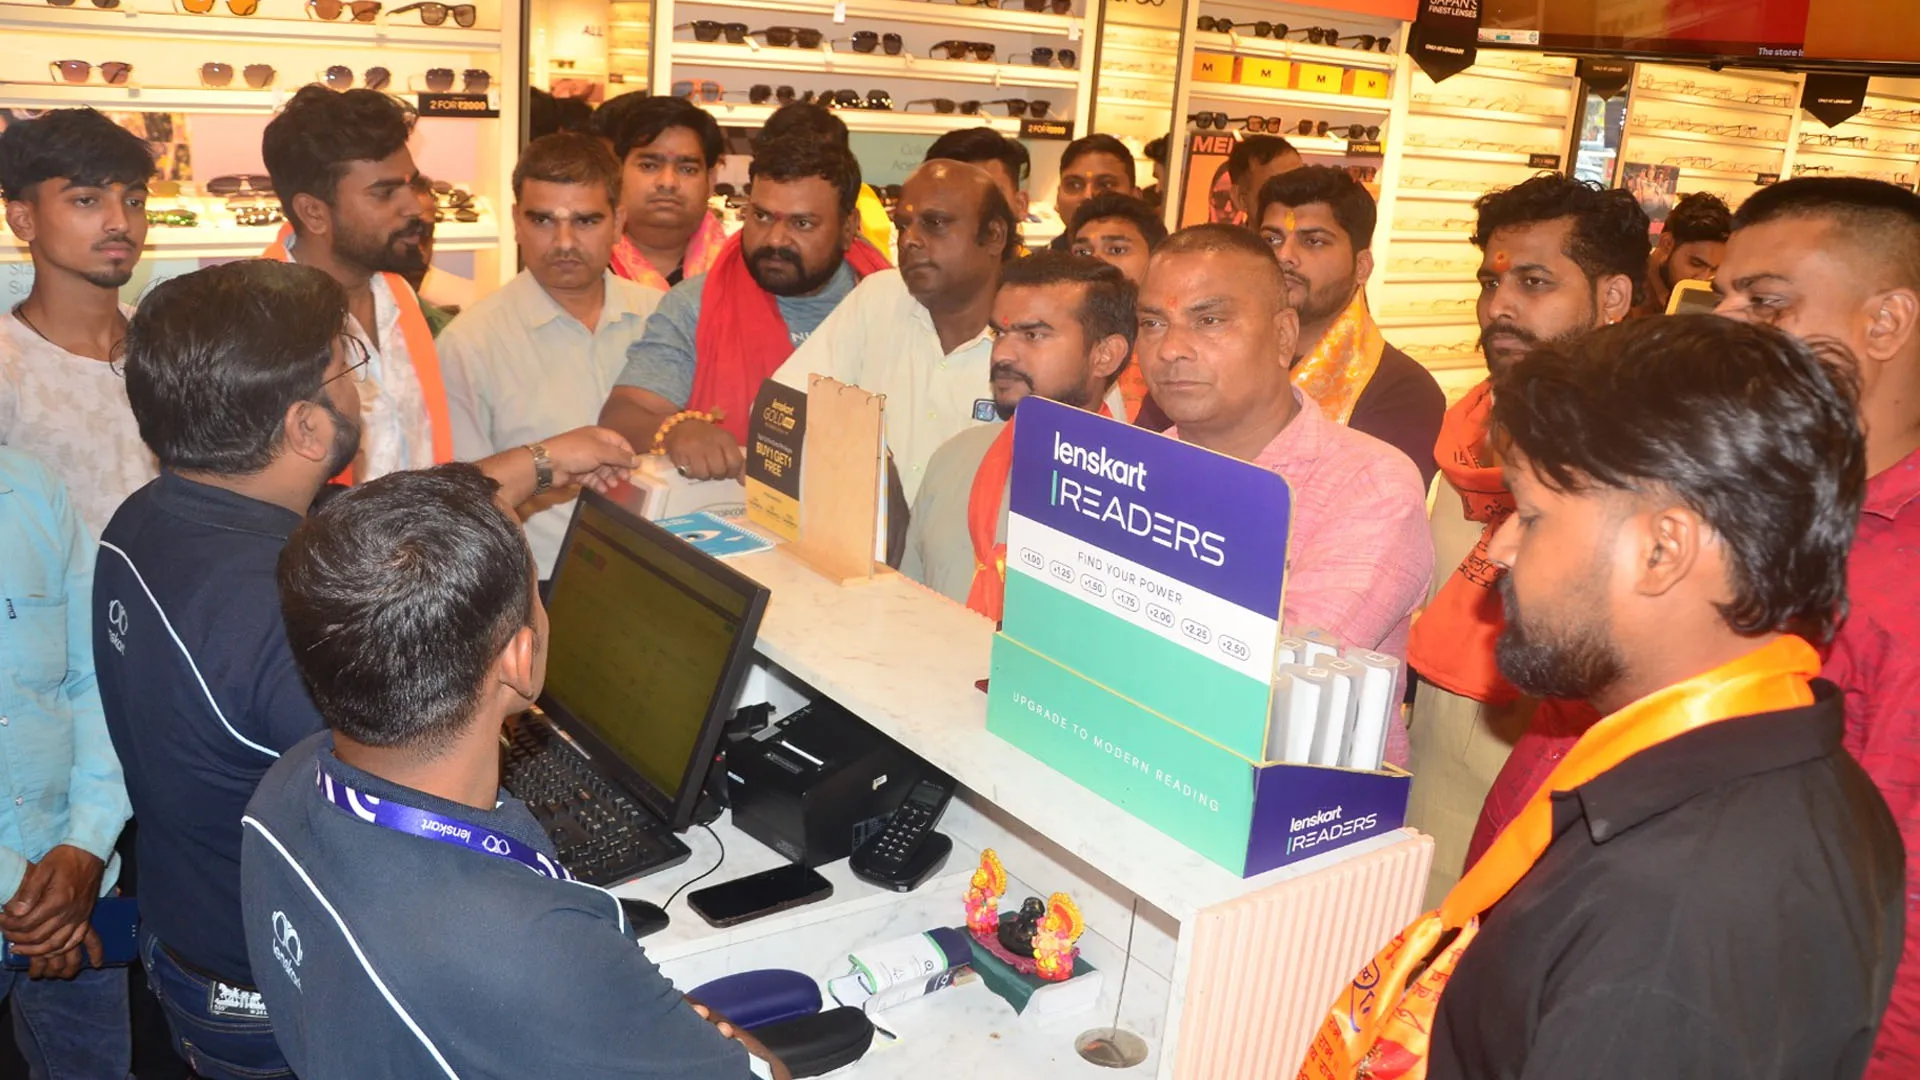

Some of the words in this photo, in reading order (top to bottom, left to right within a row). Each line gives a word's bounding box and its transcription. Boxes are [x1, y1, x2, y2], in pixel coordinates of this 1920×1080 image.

[1428, 5, 1451, 15] FINEST
[1451, 8, 1477, 18] LENSES
[1758, 47, 1773, 56] The
[1774, 49, 1798, 57] store
[1202, 62, 1213, 72] M
[1261, 69, 1271, 78] M
[1316, 75, 1326, 83] M
[1367, 80, 1376, 88] M
[429, 100, 437, 109] 2
[438, 100, 457, 109] FOR
[756, 441, 770, 457] BUY
[774, 450, 788, 466] GET
[1053, 431, 1147, 492] lenskart
[764, 458, 782, 477] FREE
[1060, 477, 1226, 567] READERS
[1078, 551, 1102, 570] FIND
[1106, 563, 1136, 585] YOUR
[1140, 577, 1182, 605] POWER
[1013, 692, 1067, 729] UPGRADE
[1073, 723, 1088, 740] TO
[1093, 735, 1150, 775] MODERN
[1155, 768, 1219, 812] READING
[1289, 805, 1342, 833] lenskart
[420, 818, 471, 844] lenskart
[1292, 813, 1378, 853] READERS
